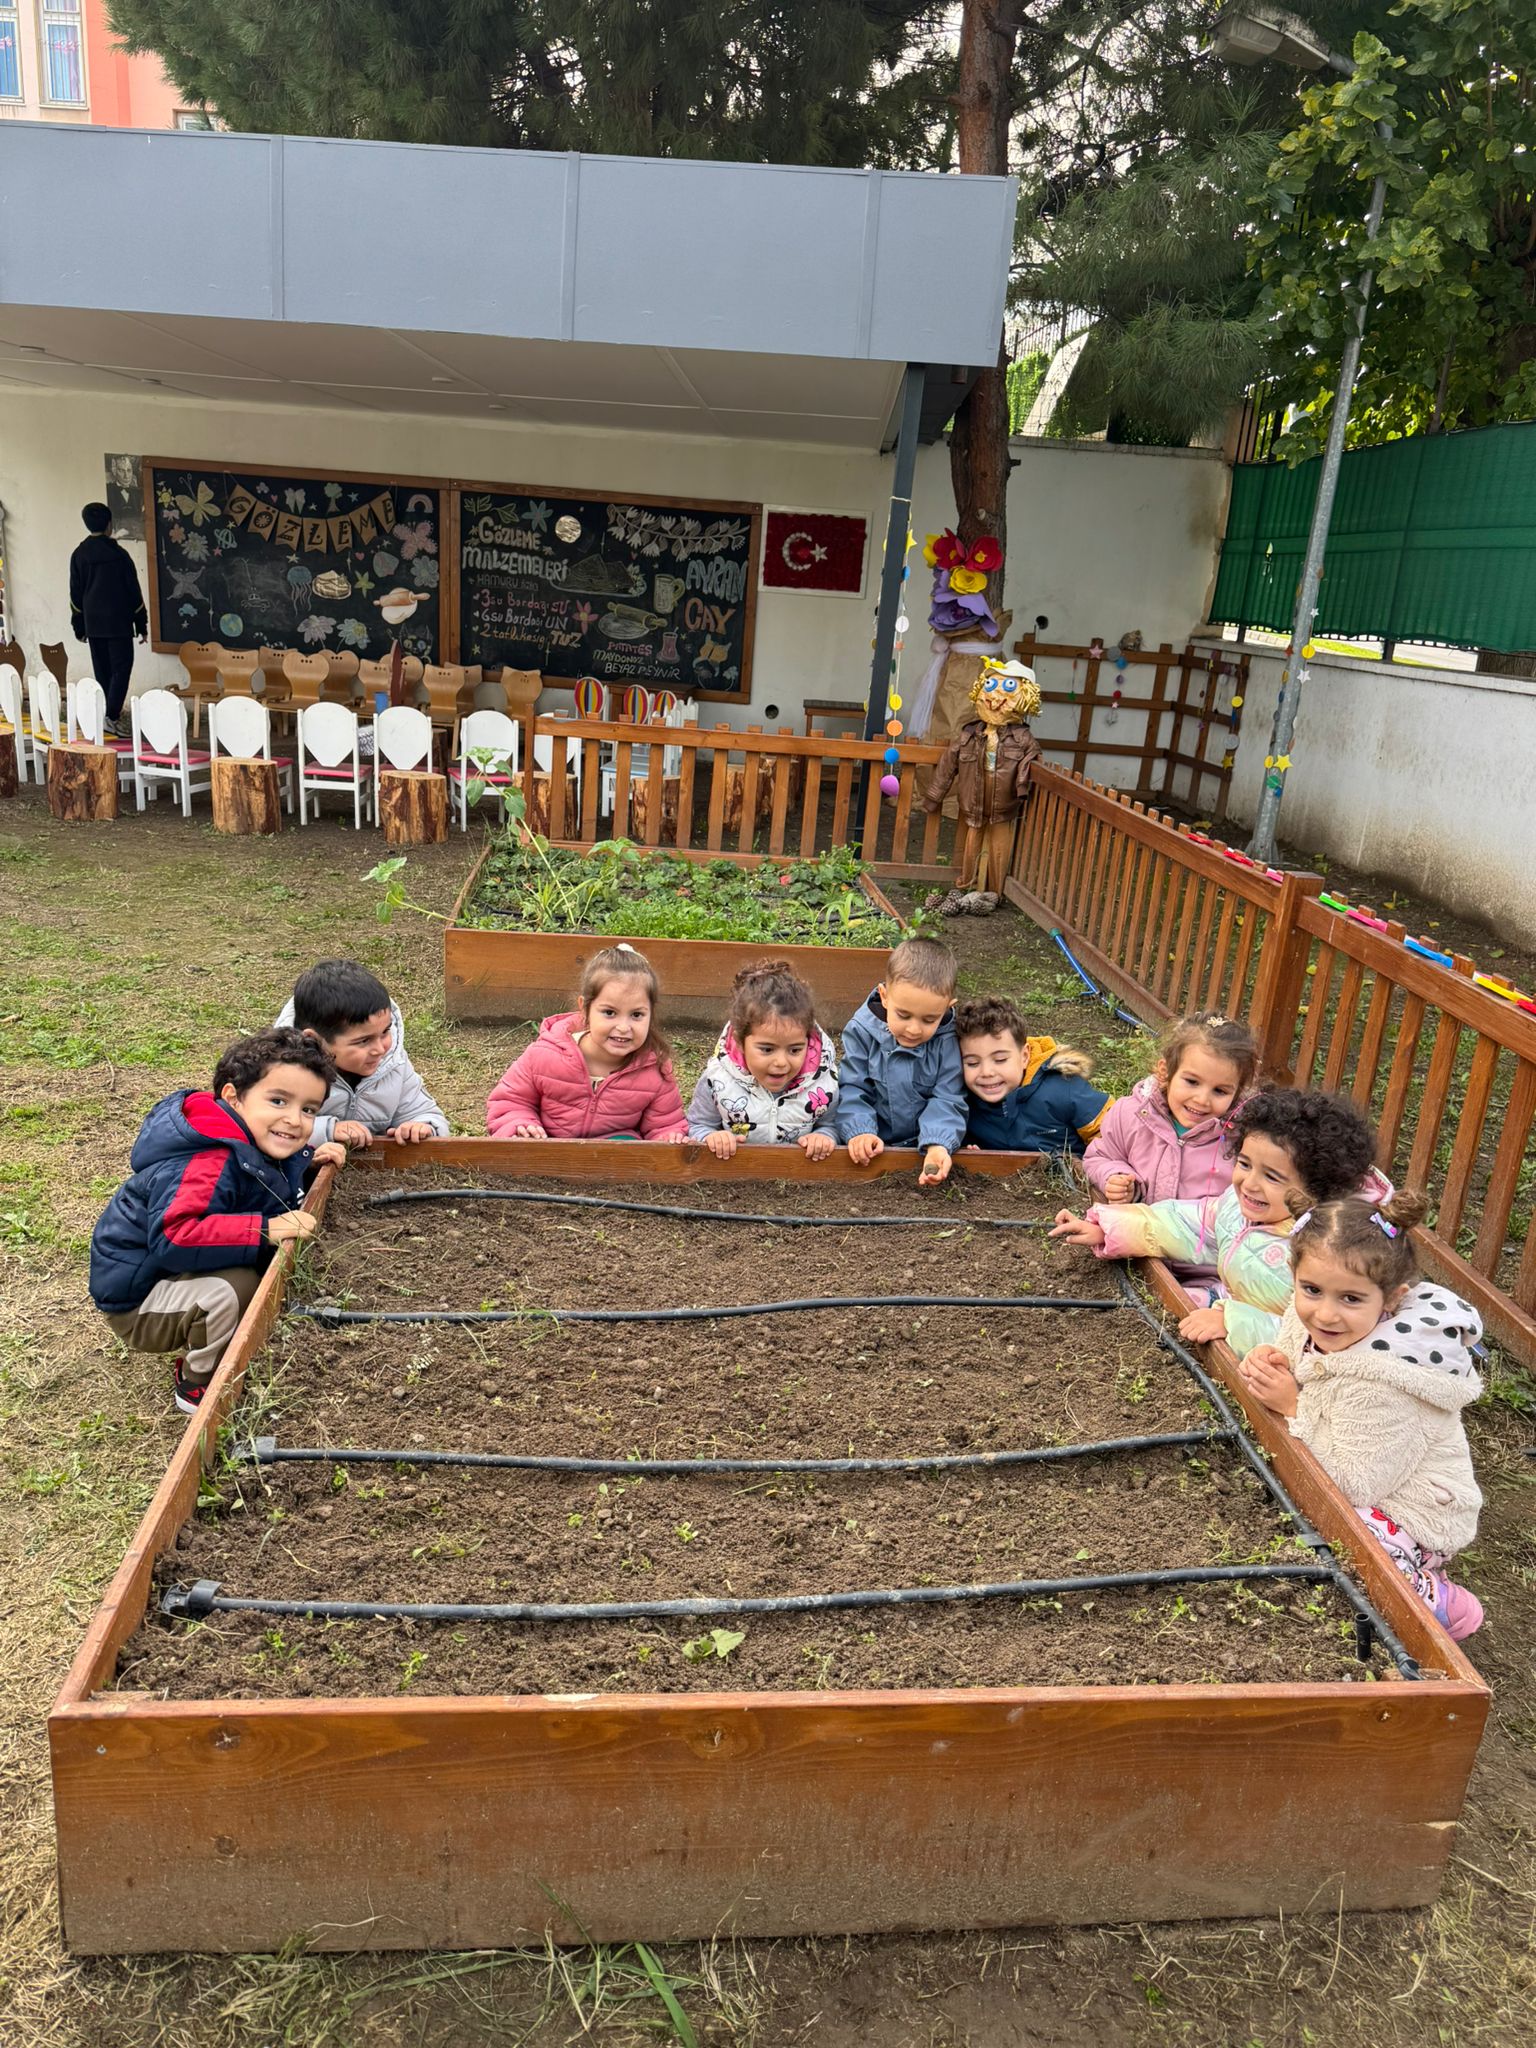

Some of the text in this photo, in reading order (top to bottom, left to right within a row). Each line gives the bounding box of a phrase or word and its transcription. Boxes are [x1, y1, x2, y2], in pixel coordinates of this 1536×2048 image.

[228, 495, 395, 546] GÖZLEME
[478, 516, 542, 550] GÖZLEME
[544, 616, 569, 630] UN
[479, 622, 491, 637] 2
[550, 630, 582, 648] TUZ
[607, 641, 653, 657] PATATES
[604, 662, 636, 674] BEYAZ
